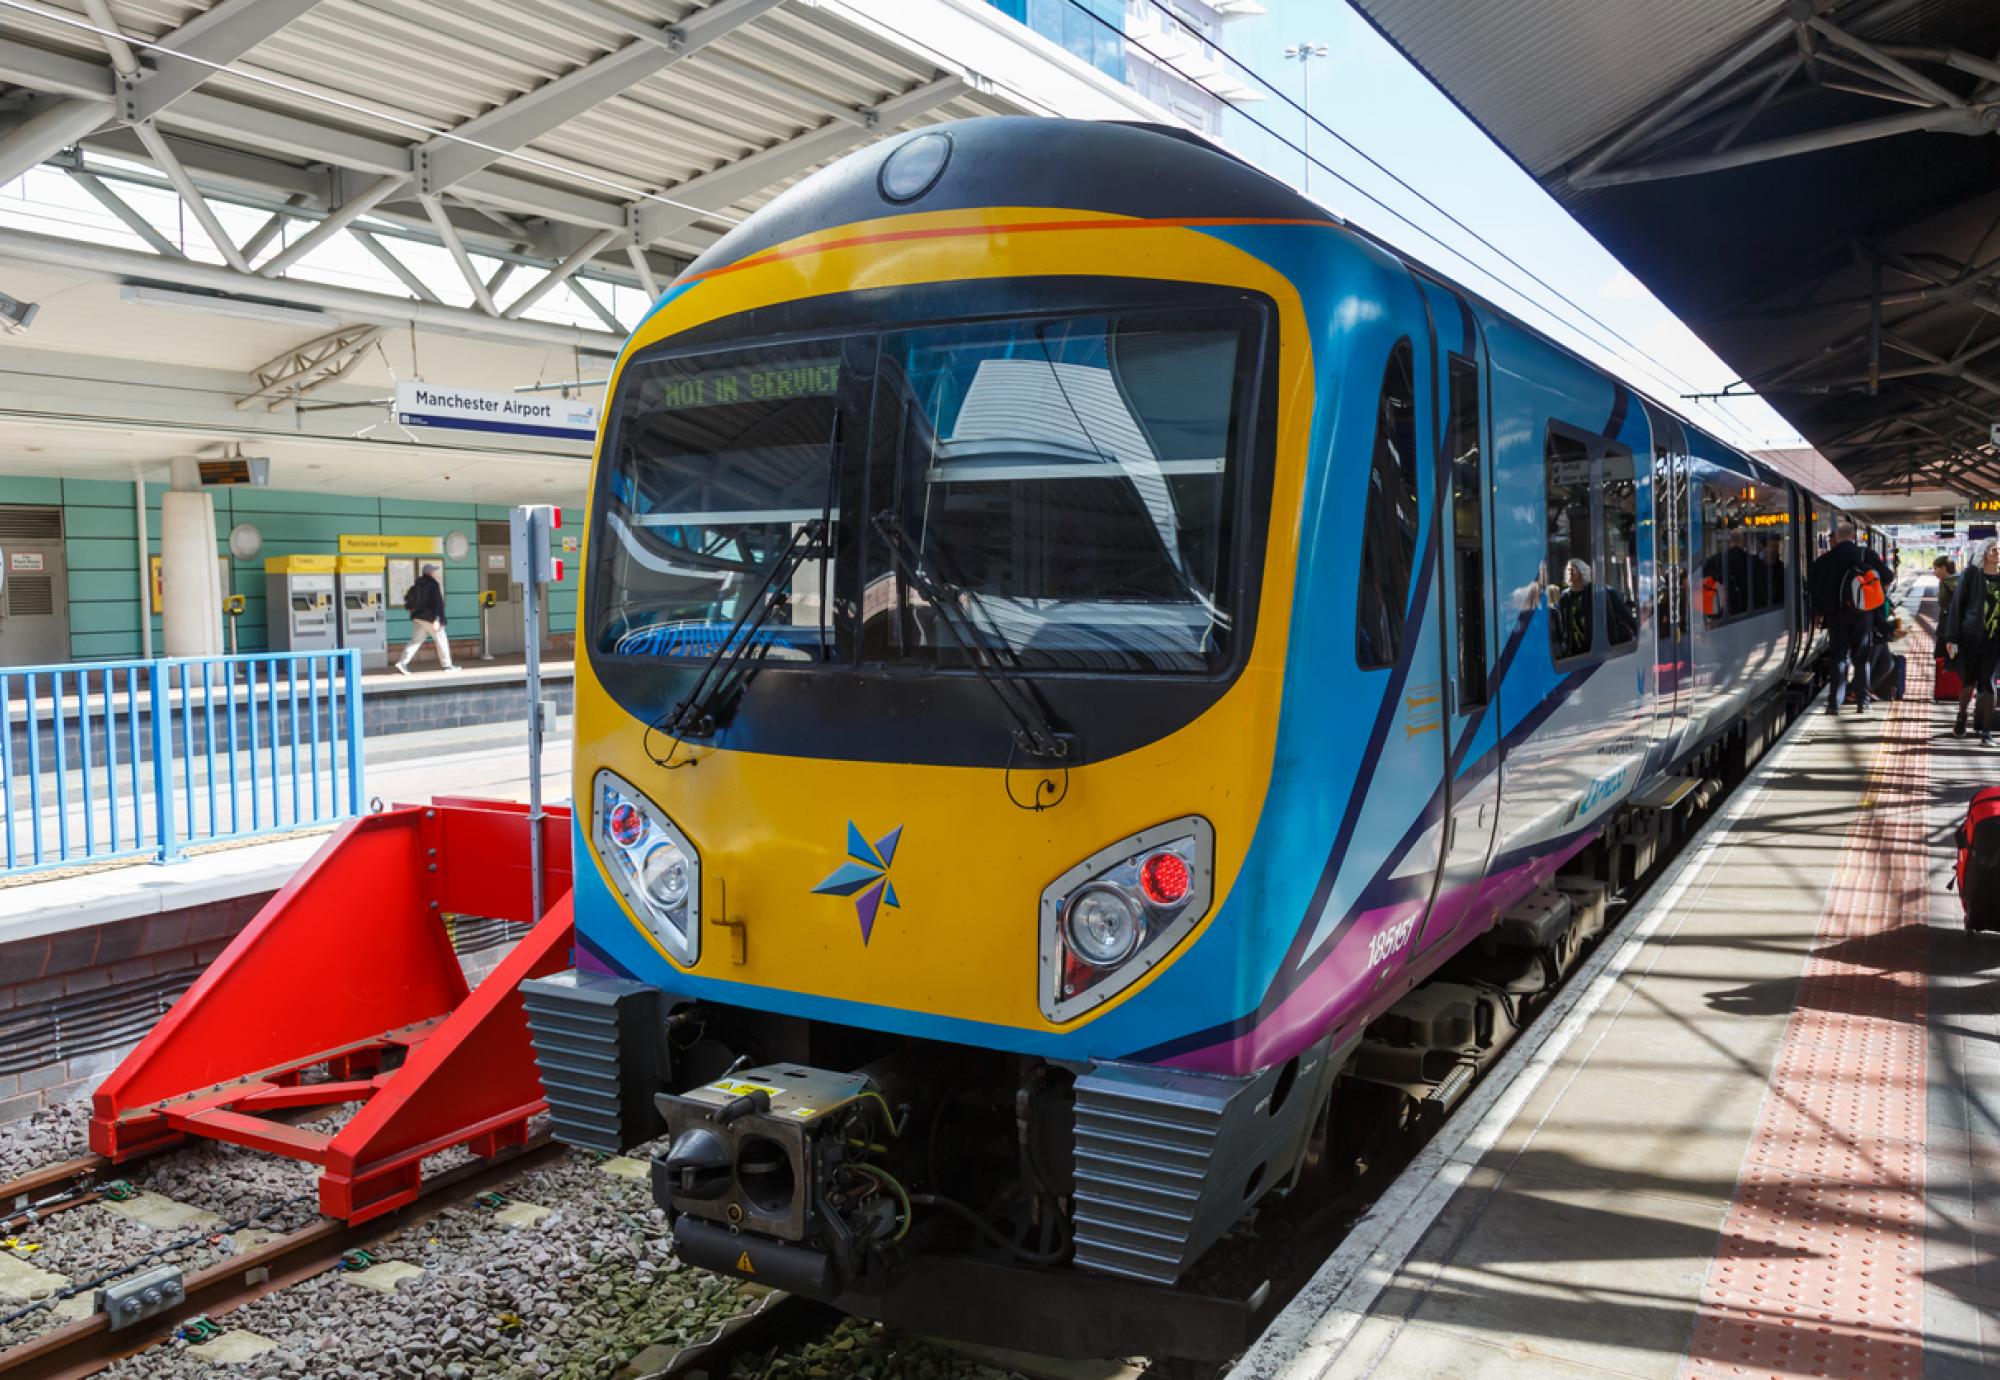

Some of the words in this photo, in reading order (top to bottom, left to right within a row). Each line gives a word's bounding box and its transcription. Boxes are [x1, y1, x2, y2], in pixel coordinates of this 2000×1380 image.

[416, 390, 499, 412] Manchester
[502, 400, 551, 418] Airport
[664, 379, 705, 407] NOT
[715, 375, 738, 402] IN
